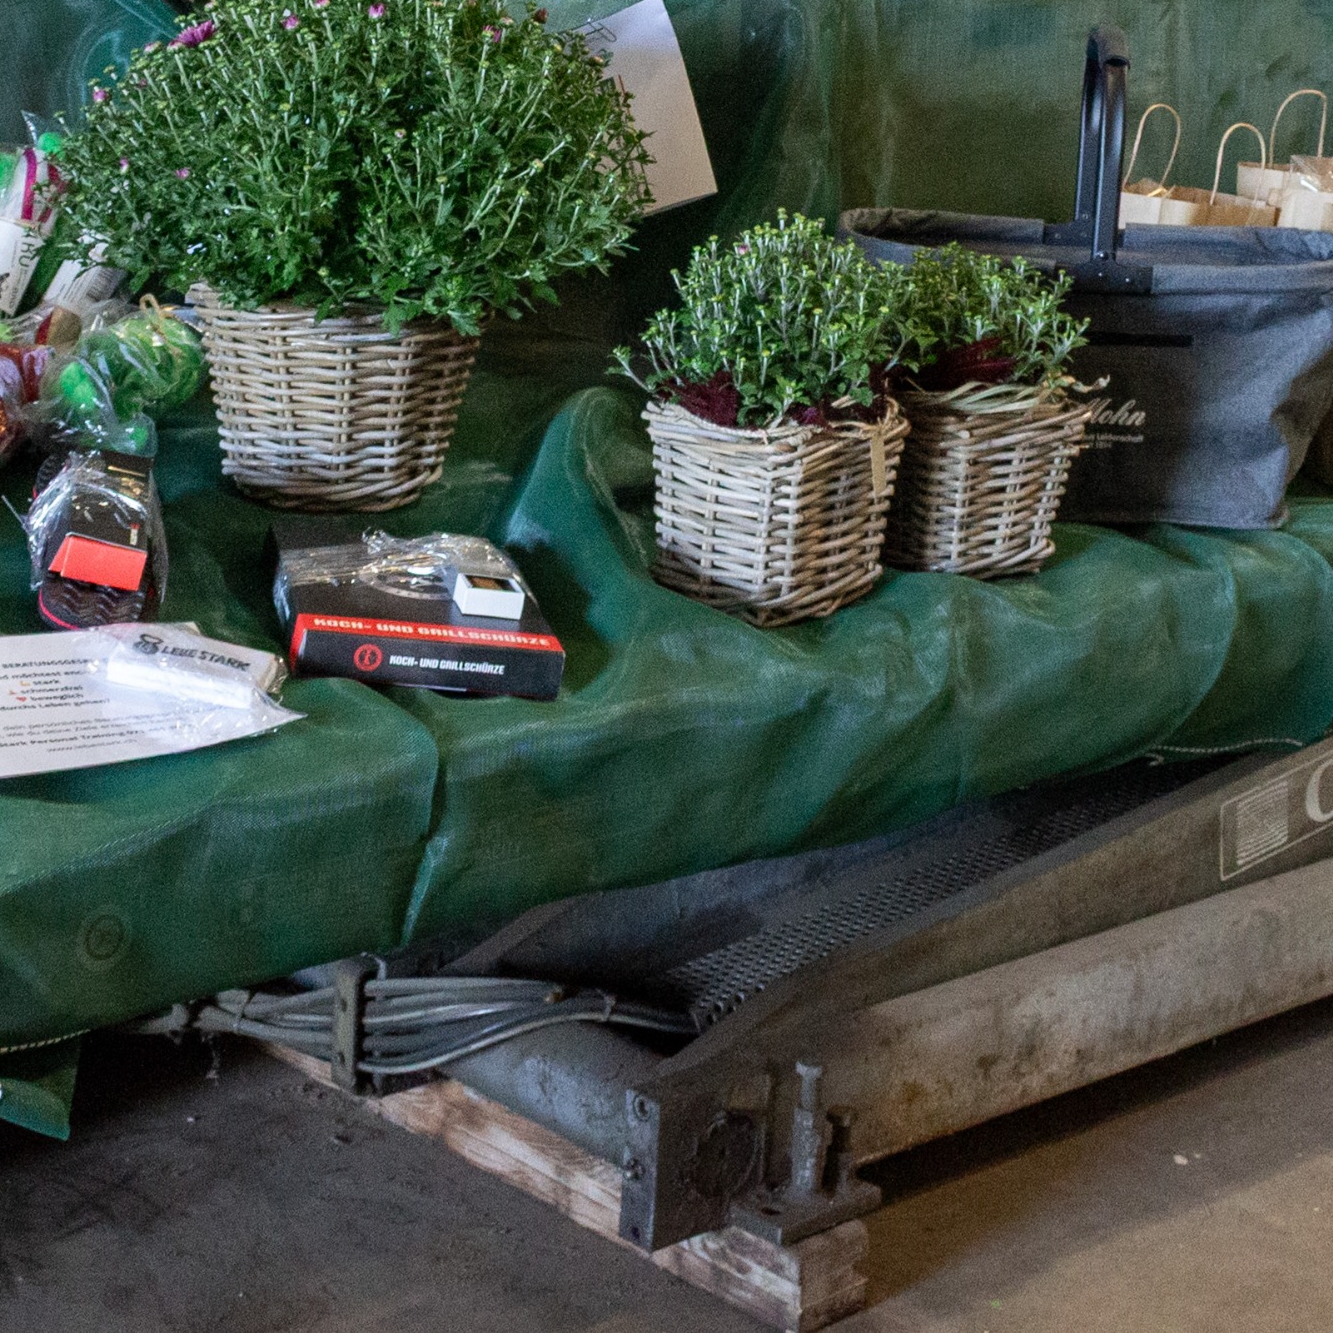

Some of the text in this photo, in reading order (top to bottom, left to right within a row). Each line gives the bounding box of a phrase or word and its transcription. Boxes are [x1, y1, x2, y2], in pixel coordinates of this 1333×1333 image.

[313, 617, 551, 647] KOCH- UND GRILLSCHÜRZE
[160, 645, 251, 671] LEBE STARK
[389, 655, 505, 675] KOCH- UND GRILLSCHÜRZE
